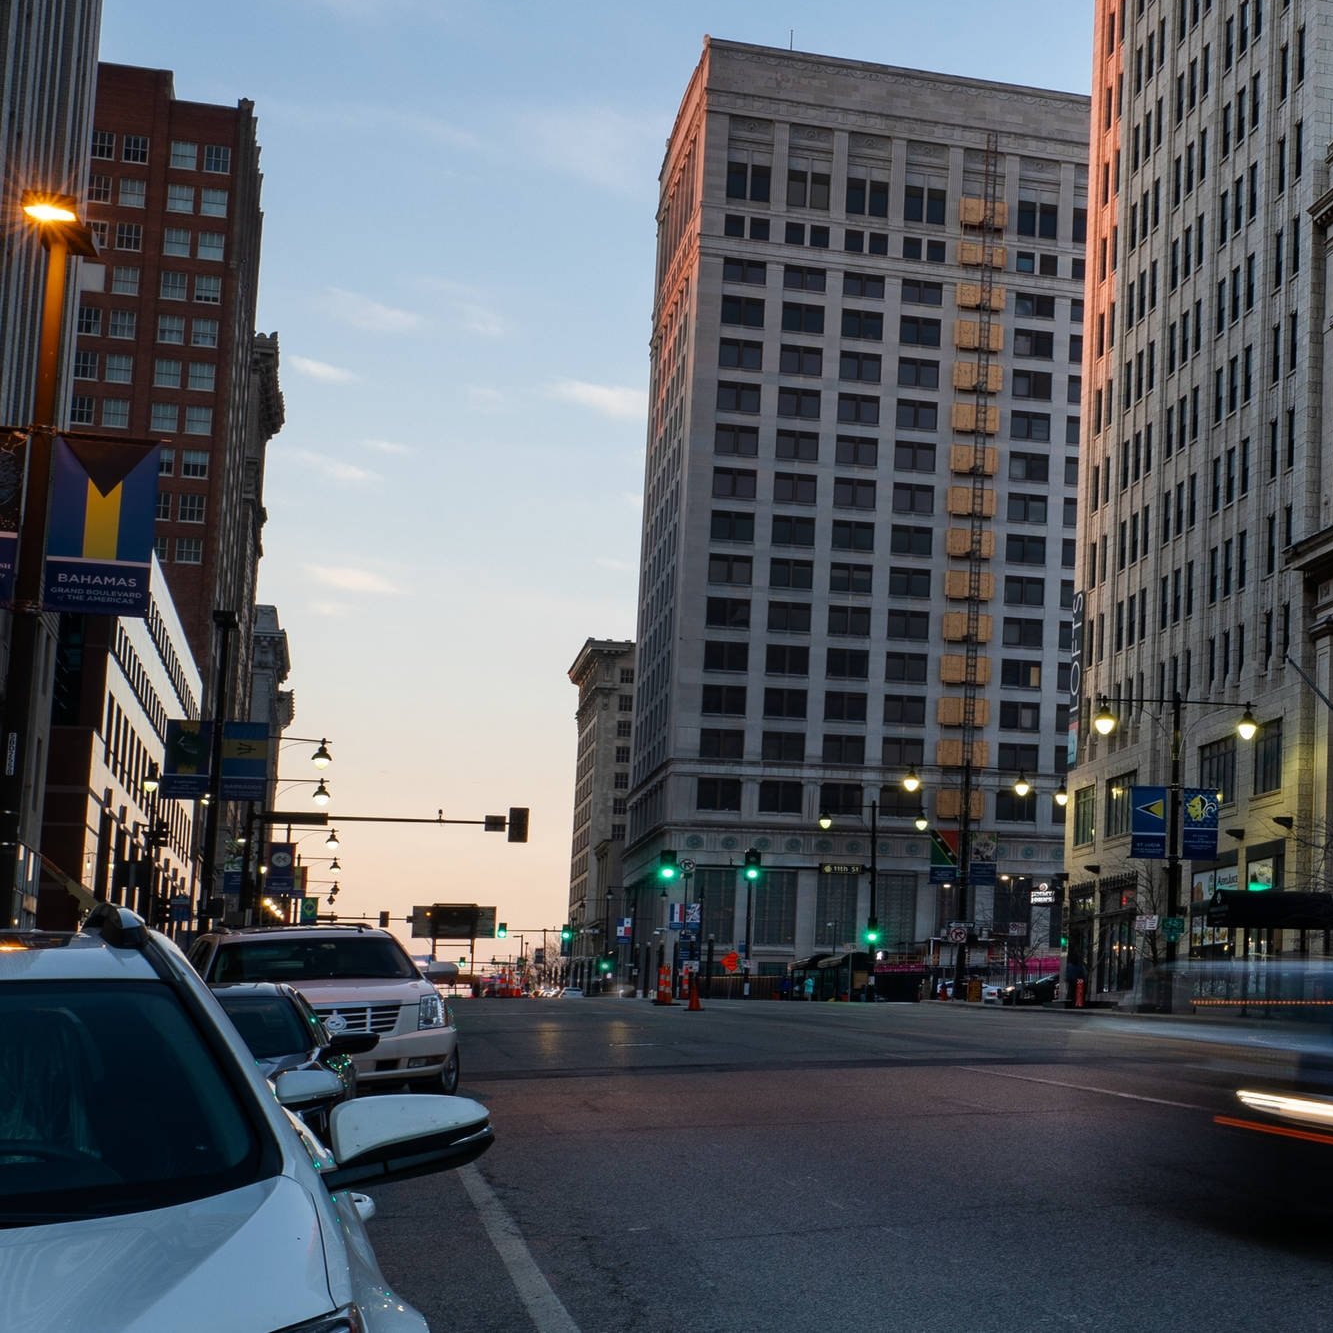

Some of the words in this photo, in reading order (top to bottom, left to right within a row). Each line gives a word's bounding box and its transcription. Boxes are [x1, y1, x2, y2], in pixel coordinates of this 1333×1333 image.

[58, 573, 137, 587] BAHAMAS
[50, 586, 85, 597] GRAND
[87, 588, 143, 600] BOULEVARD
[67, 594, 88, 602] THE
[90, 596, 134, 604] AMERICAS
[1069, 593, 1083, 713] LOFTS
